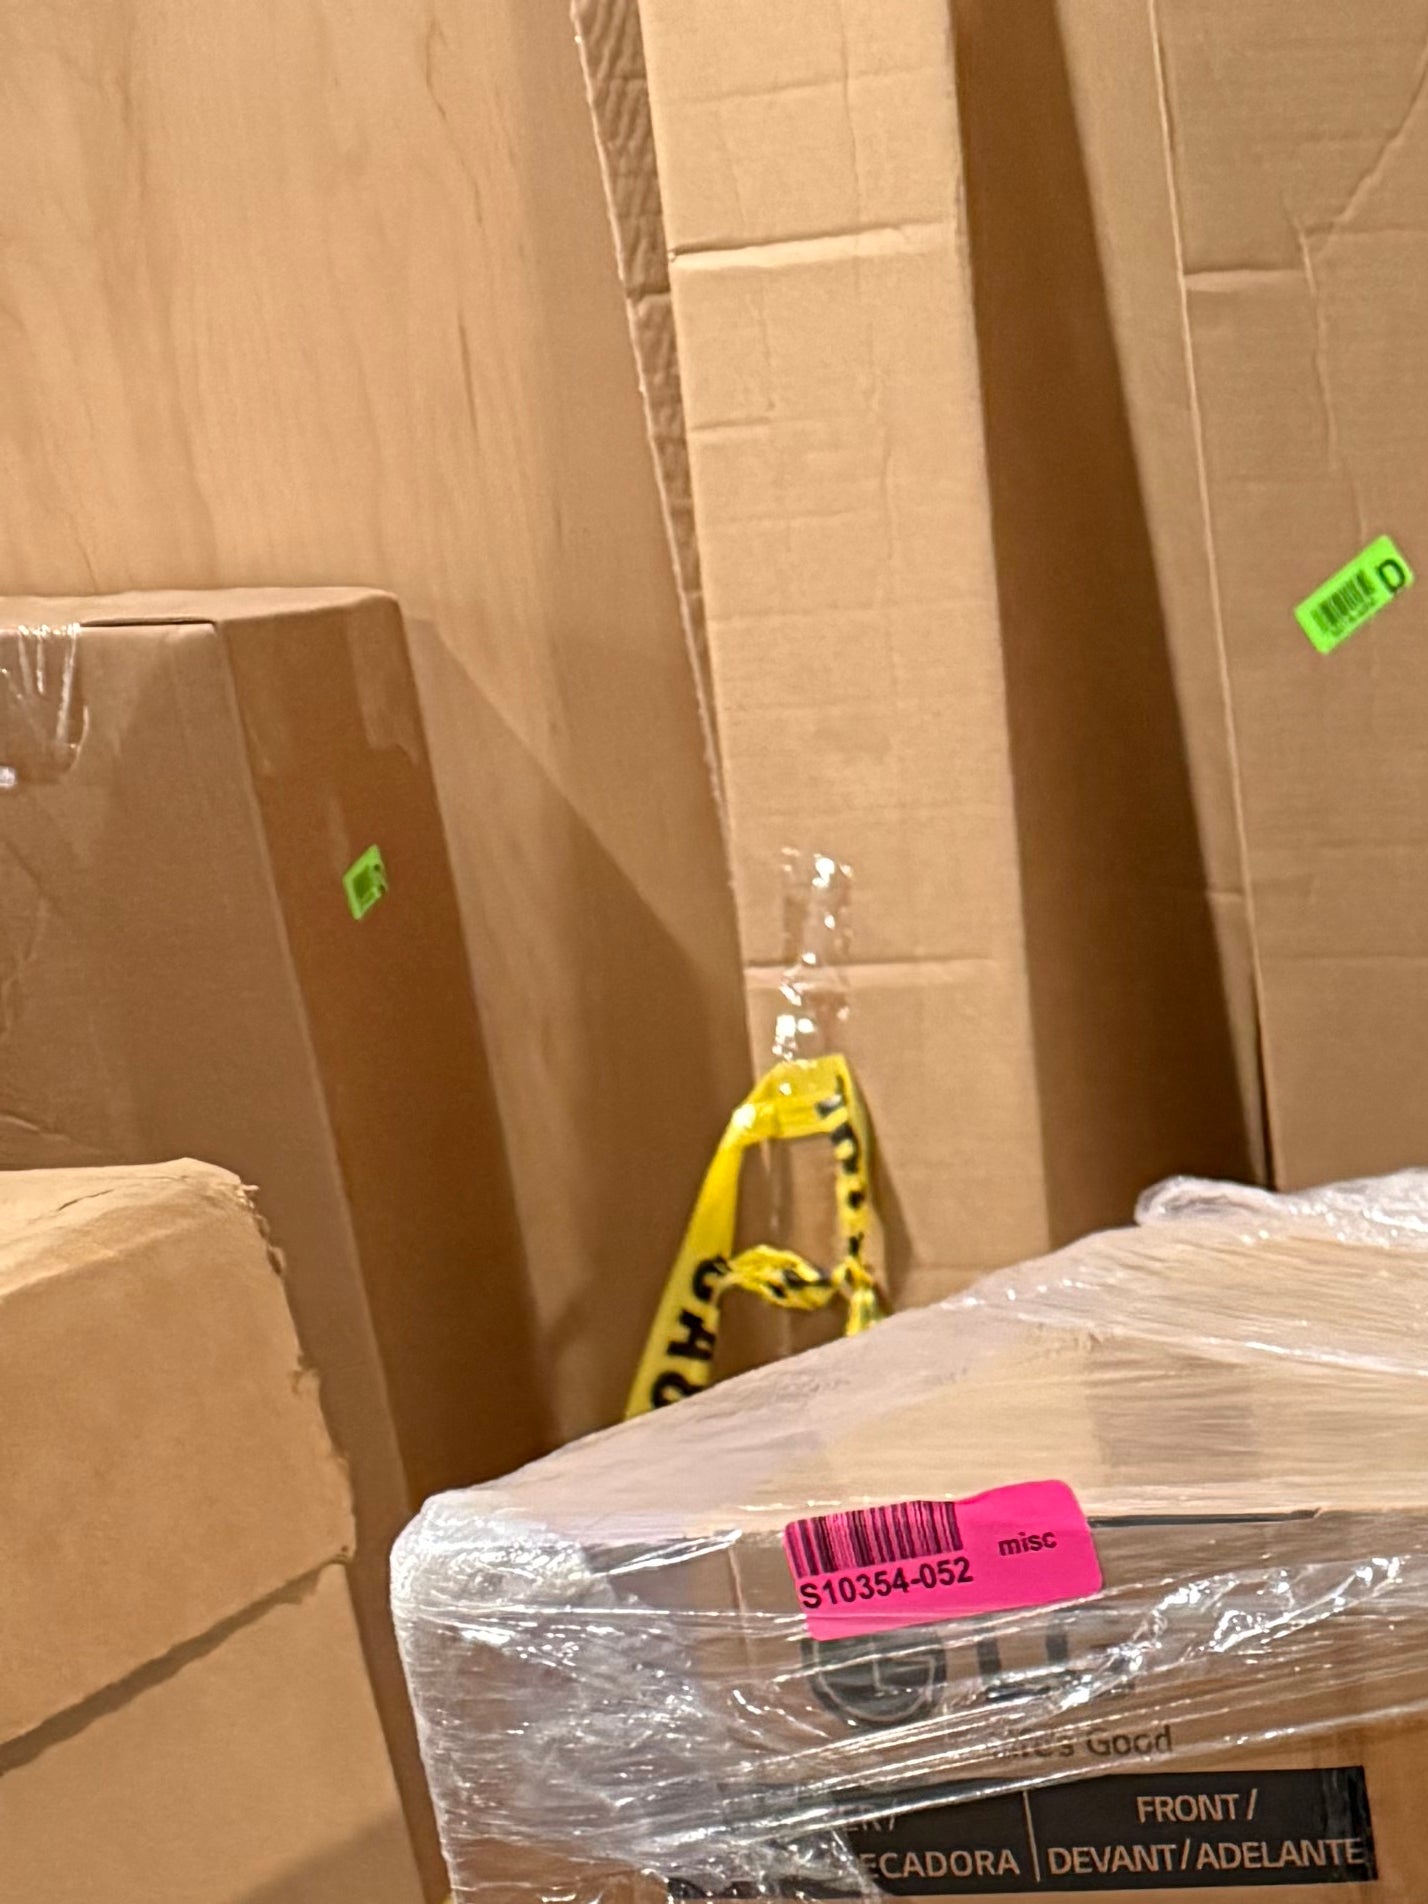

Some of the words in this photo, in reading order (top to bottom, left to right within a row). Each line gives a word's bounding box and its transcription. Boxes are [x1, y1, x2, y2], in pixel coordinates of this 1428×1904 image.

[1376, 558, 1407, 594] D
[998, 1528, 1058, 1558] misc
[801, 1556, 975, 1611] S10354-052
[1087, 1724, 1173, 1758] Good
[1136, 1794, 1239, 1825] FRONT
[856, 1846, 1022, 1879] ECADORA
